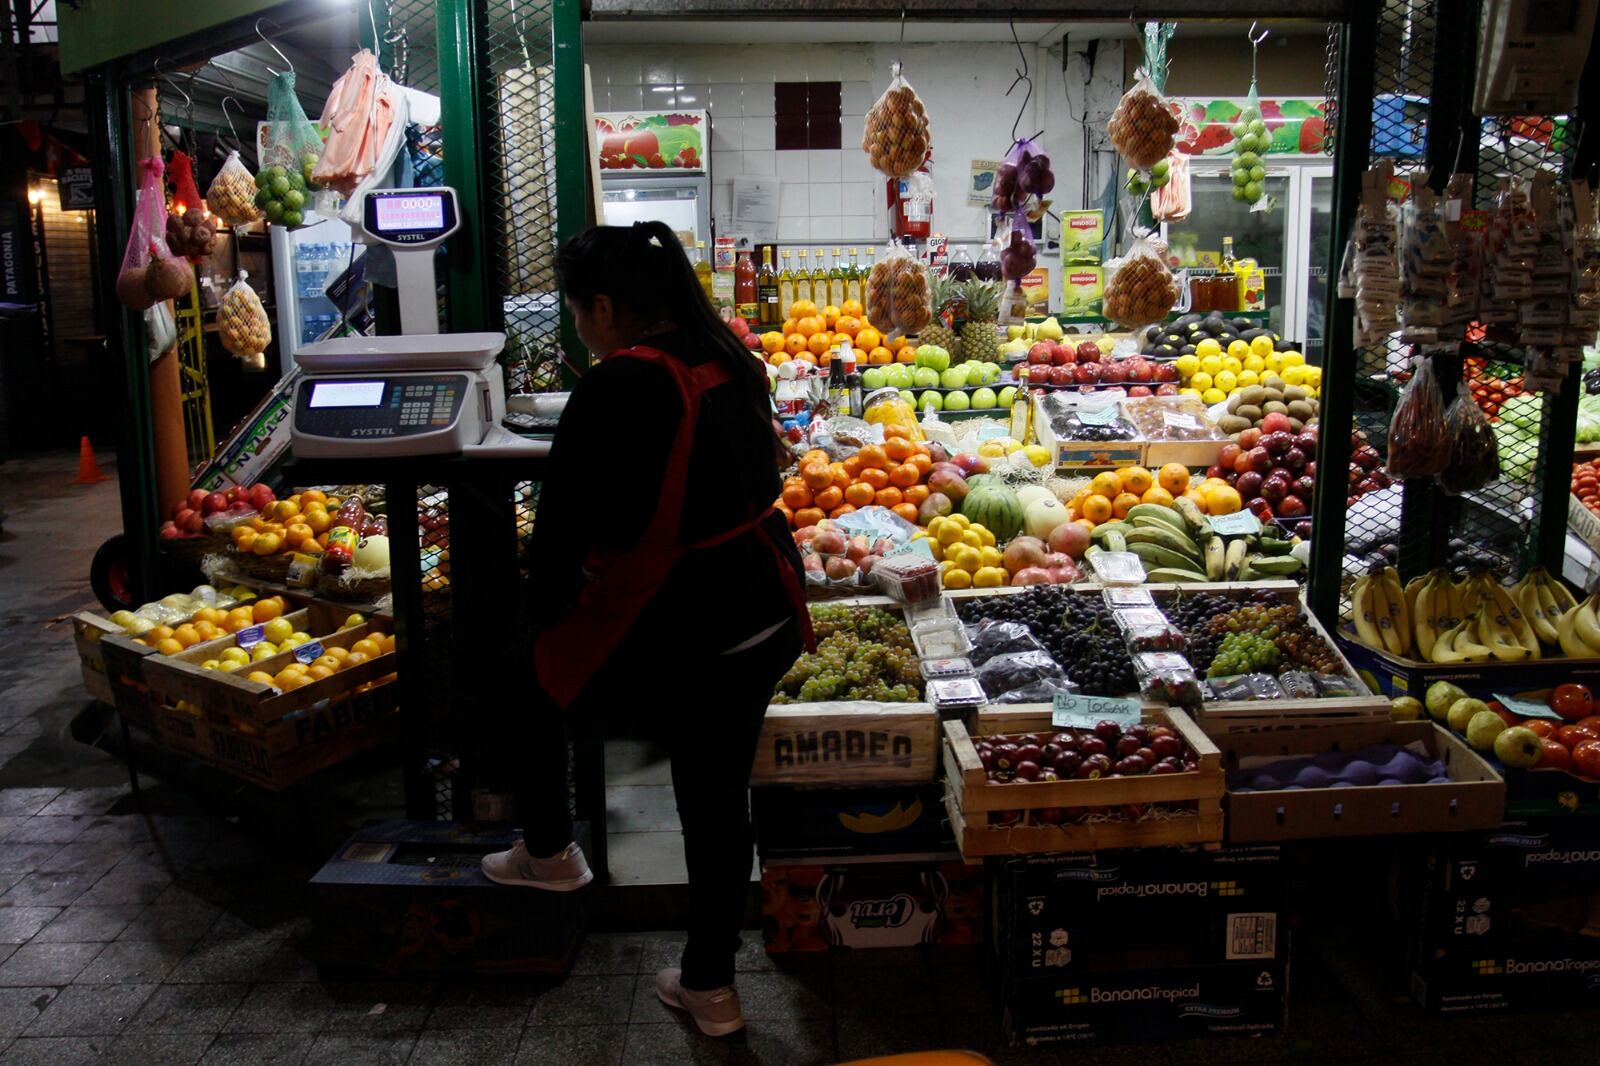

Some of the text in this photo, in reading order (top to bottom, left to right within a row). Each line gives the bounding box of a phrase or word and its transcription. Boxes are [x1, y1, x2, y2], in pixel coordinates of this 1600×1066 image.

[1, 231, 18, 295] PATAGONIA
[227, 408, 289, 475] PATALANO
[351, 427, 396, 437] SYSTEL
[1056, 695, 1077, 710] NO
[774, 730, 912, 768] AMADEO
[1097, 881, 1208, 903] BananaTropical
[851, 893, 914, 928] Cervi
[1031, 931, 1042, 947] 22
[1031, 959, 1042, 968] U
[1090, 982, 1200, 1004] BananaTropical
